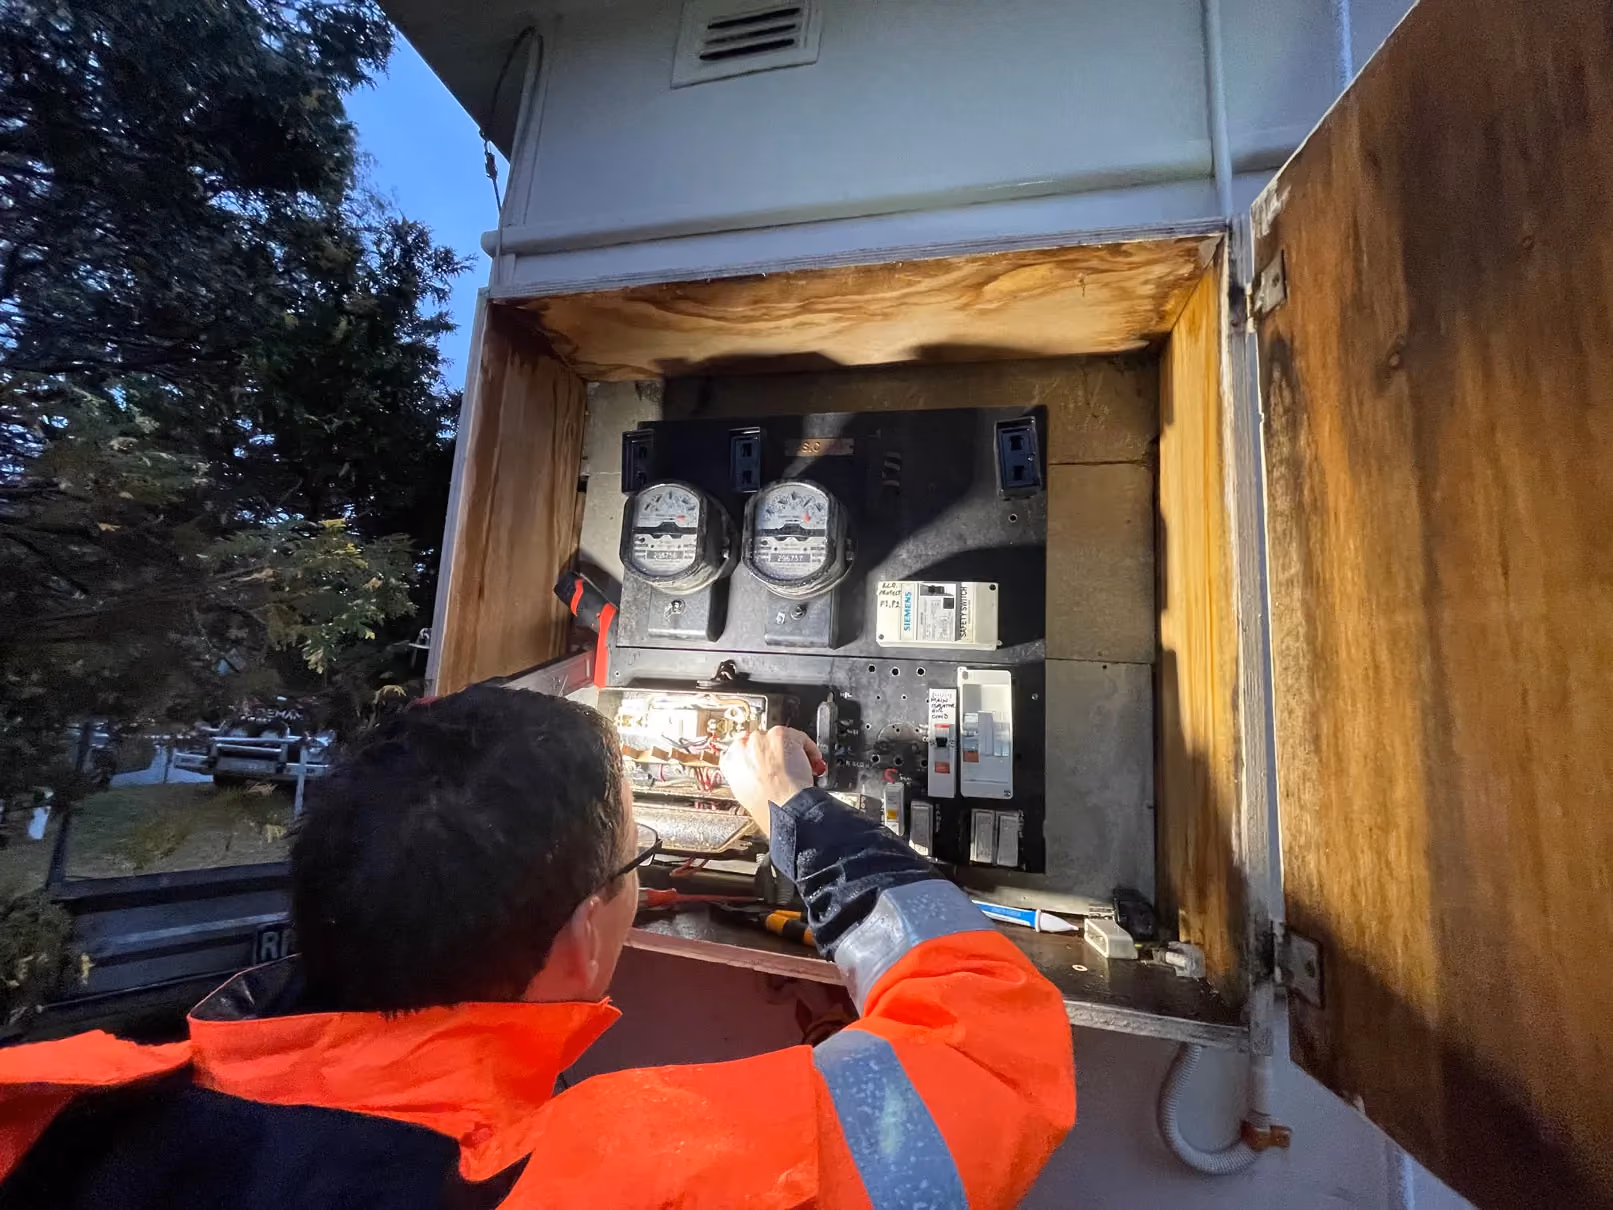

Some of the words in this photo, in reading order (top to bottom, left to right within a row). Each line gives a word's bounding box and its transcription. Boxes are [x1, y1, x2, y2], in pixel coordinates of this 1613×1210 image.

[903, 591, 912, 631] SIEMENS
[960, 586, 968, 610] SWITCH
[960, 612, 968, 638] SAFETY
